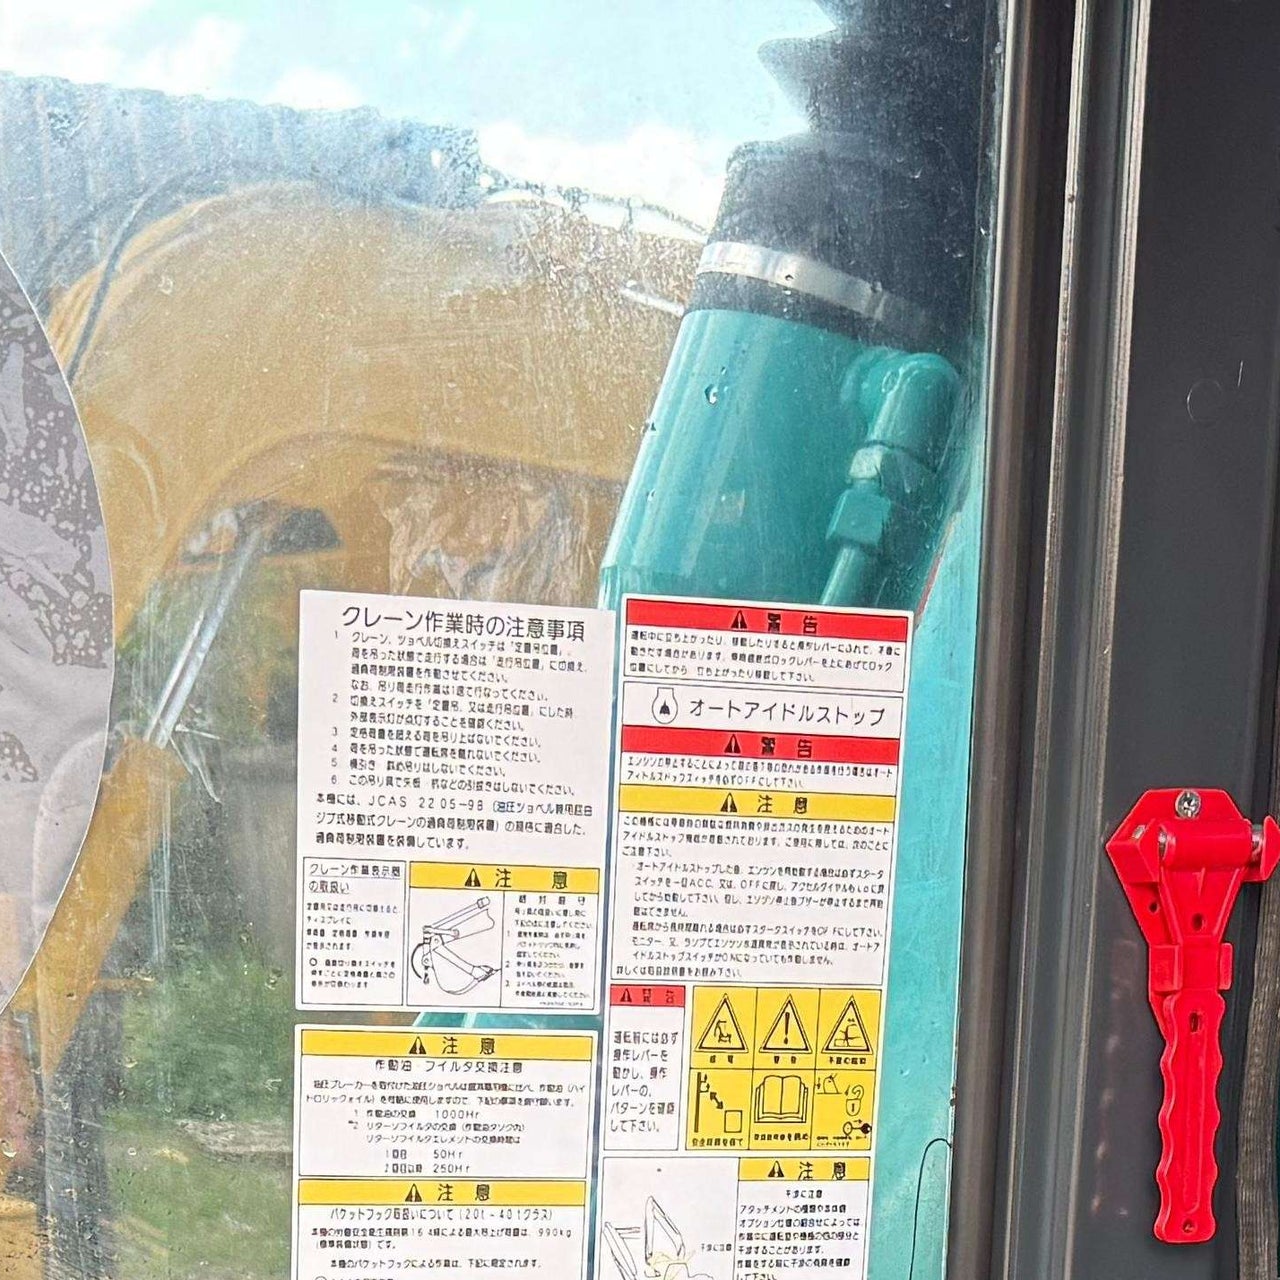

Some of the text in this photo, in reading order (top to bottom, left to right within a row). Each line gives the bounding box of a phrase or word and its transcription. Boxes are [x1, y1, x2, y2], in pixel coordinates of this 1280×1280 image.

[342, 606, 585, 642] クレーン作業時の注意事項
[767, 613, 818, 634] 警告
[689, 699, 885, 727] オートアイドルストップ
[761, 736, 812, 758] 警告
[368, 795, 407, 808] JCAS
[435, 1109, 480, 1120] 1000Hr
